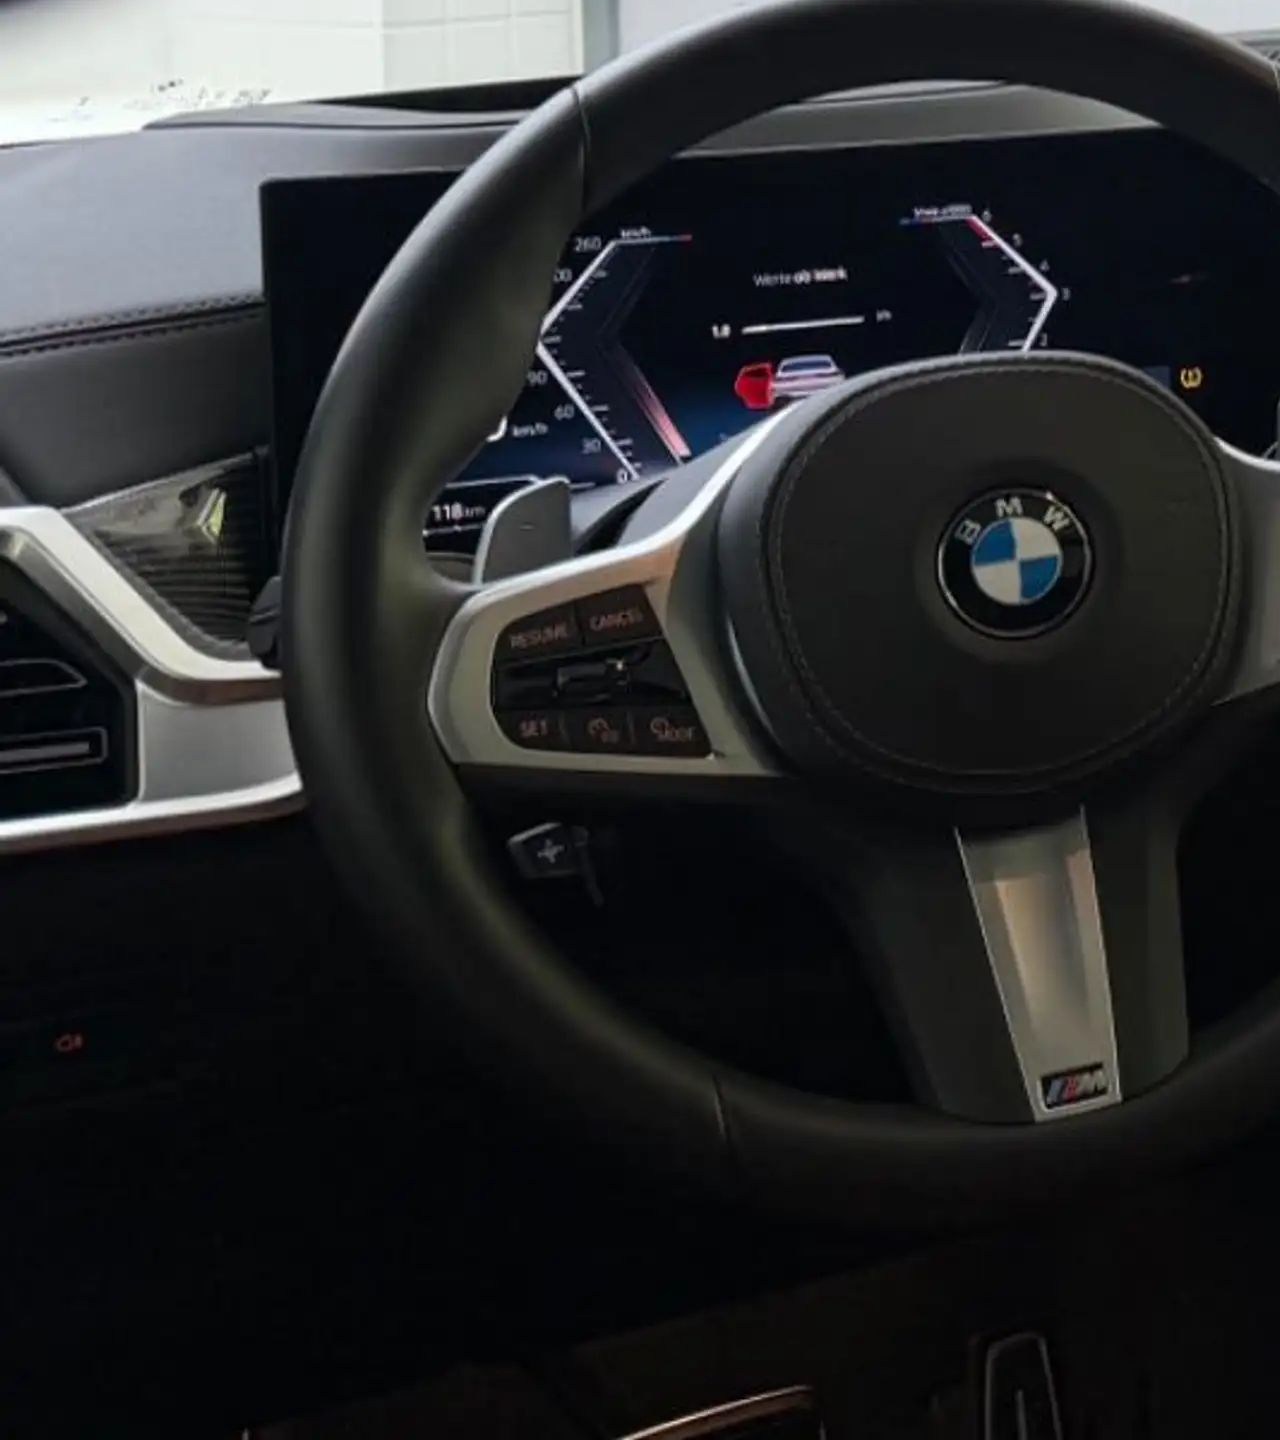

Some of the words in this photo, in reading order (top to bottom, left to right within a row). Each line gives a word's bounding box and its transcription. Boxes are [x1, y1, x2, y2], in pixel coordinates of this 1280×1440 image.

[573, 235, 602, 253] 260
[554, 403, 575, 422] 60
[953, 496, 1071, 546] BMW
[509, 621, 570, 650] RESUME
[517, 714, 549, 739] SET
